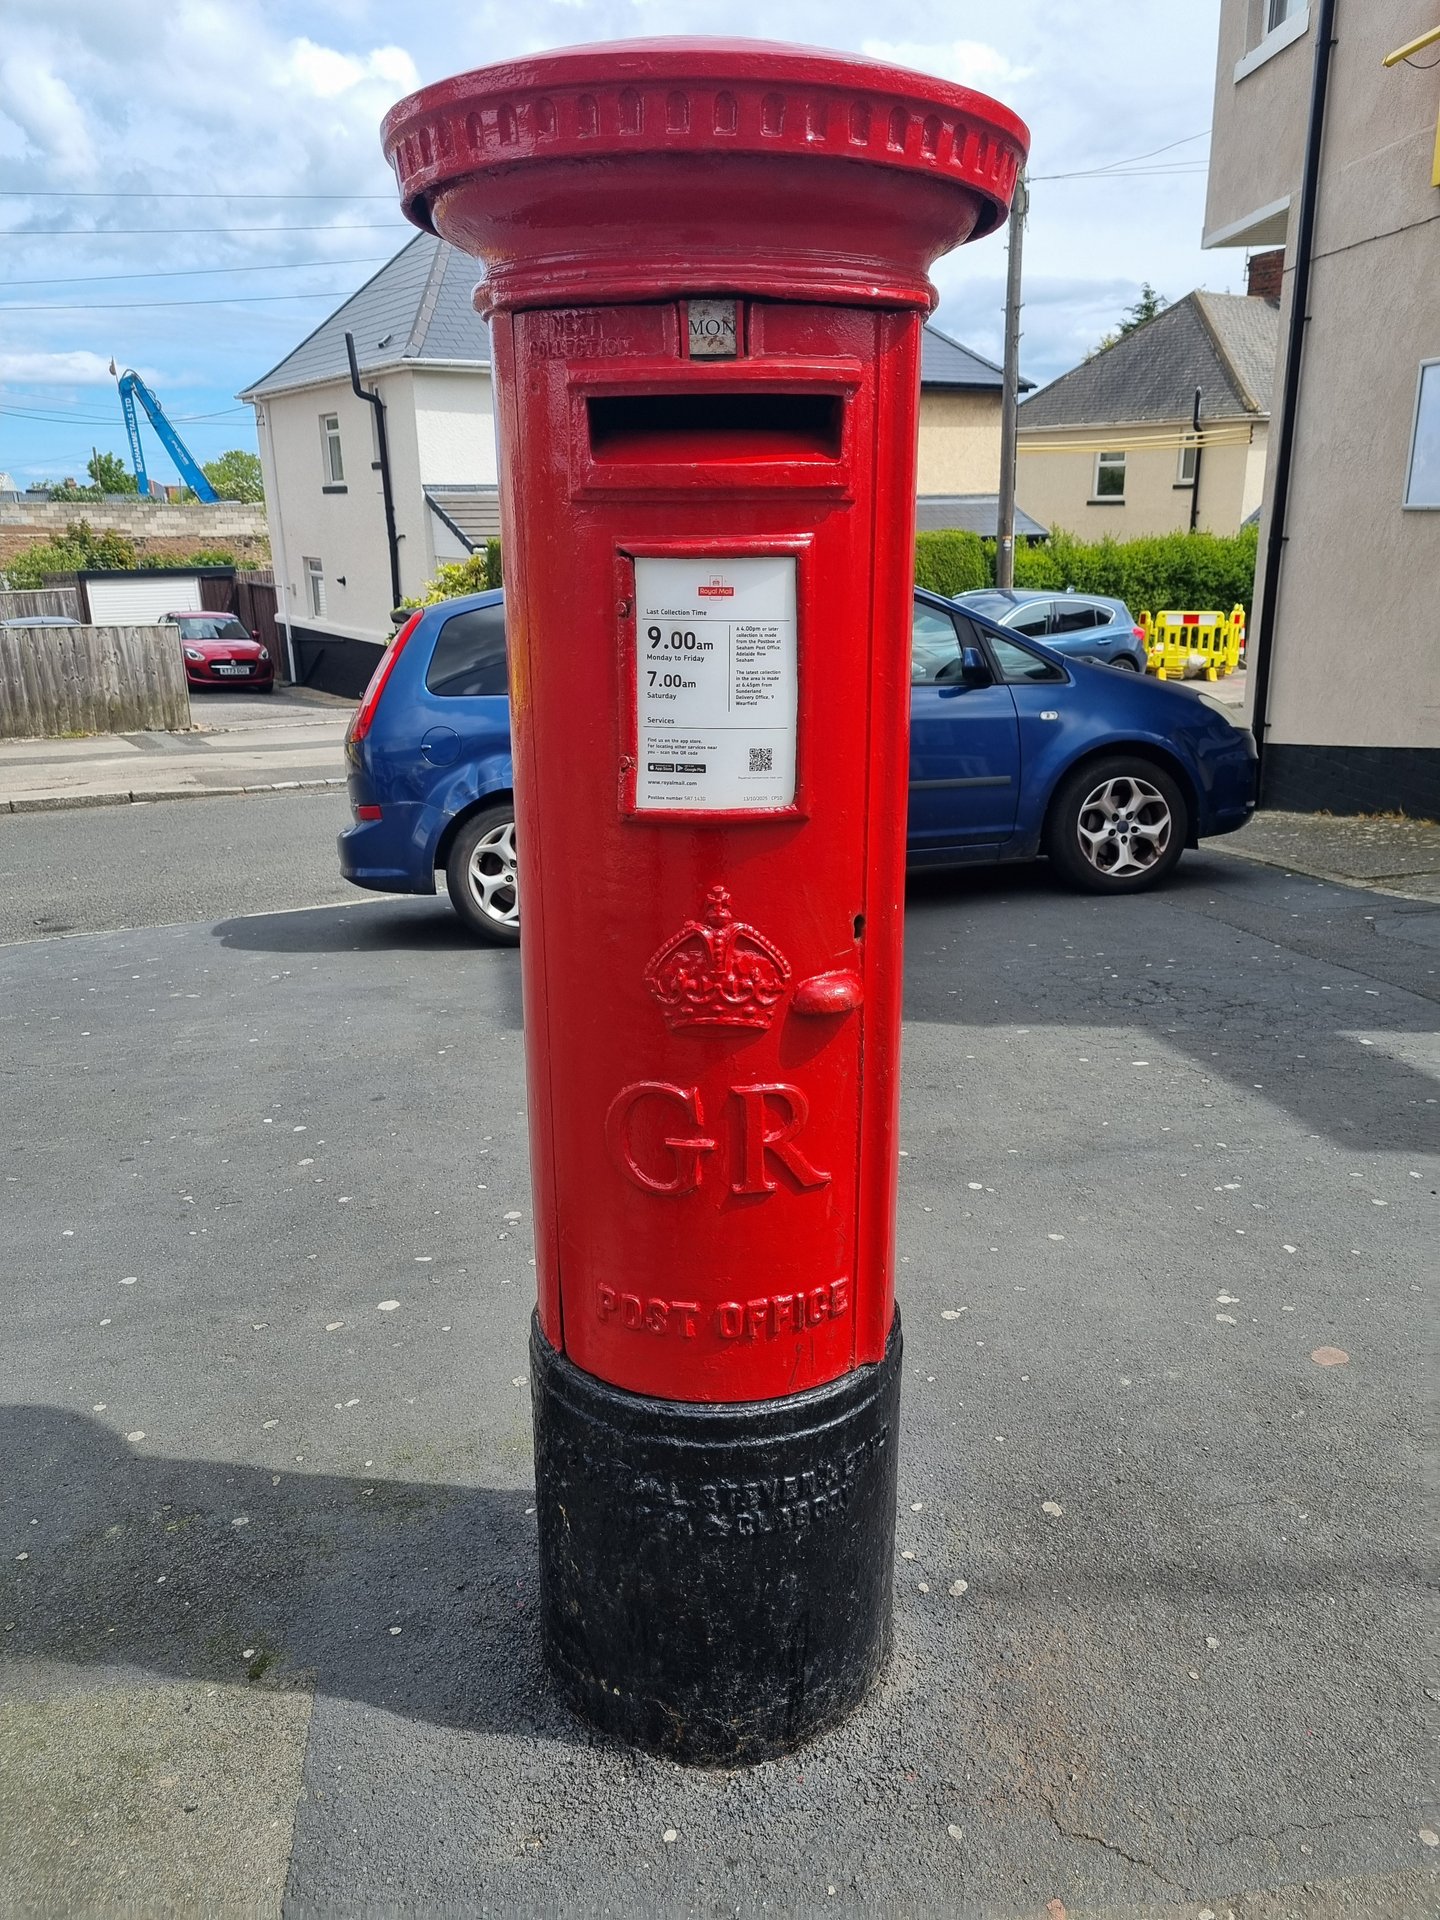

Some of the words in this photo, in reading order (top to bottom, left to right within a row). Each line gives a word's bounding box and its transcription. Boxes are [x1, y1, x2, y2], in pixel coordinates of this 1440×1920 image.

[552, 312, 604, 338] NEXT
[688, 319, 736, 336] MON
[124, 397, 134, 412] LTD
[647, 626, 714, 650] 9.00am
[646, 654, 672, 662] Monday
[684, 655, 705, 663] Friday
[646, 671, 696, 688] 7.00am
[647, 692, 677, 700] Saturday
[606, 1079, 832, 1196] GR
[597, 1282, 700, 1338] POST
[717, 1276, 849, 1338] OFFICE
